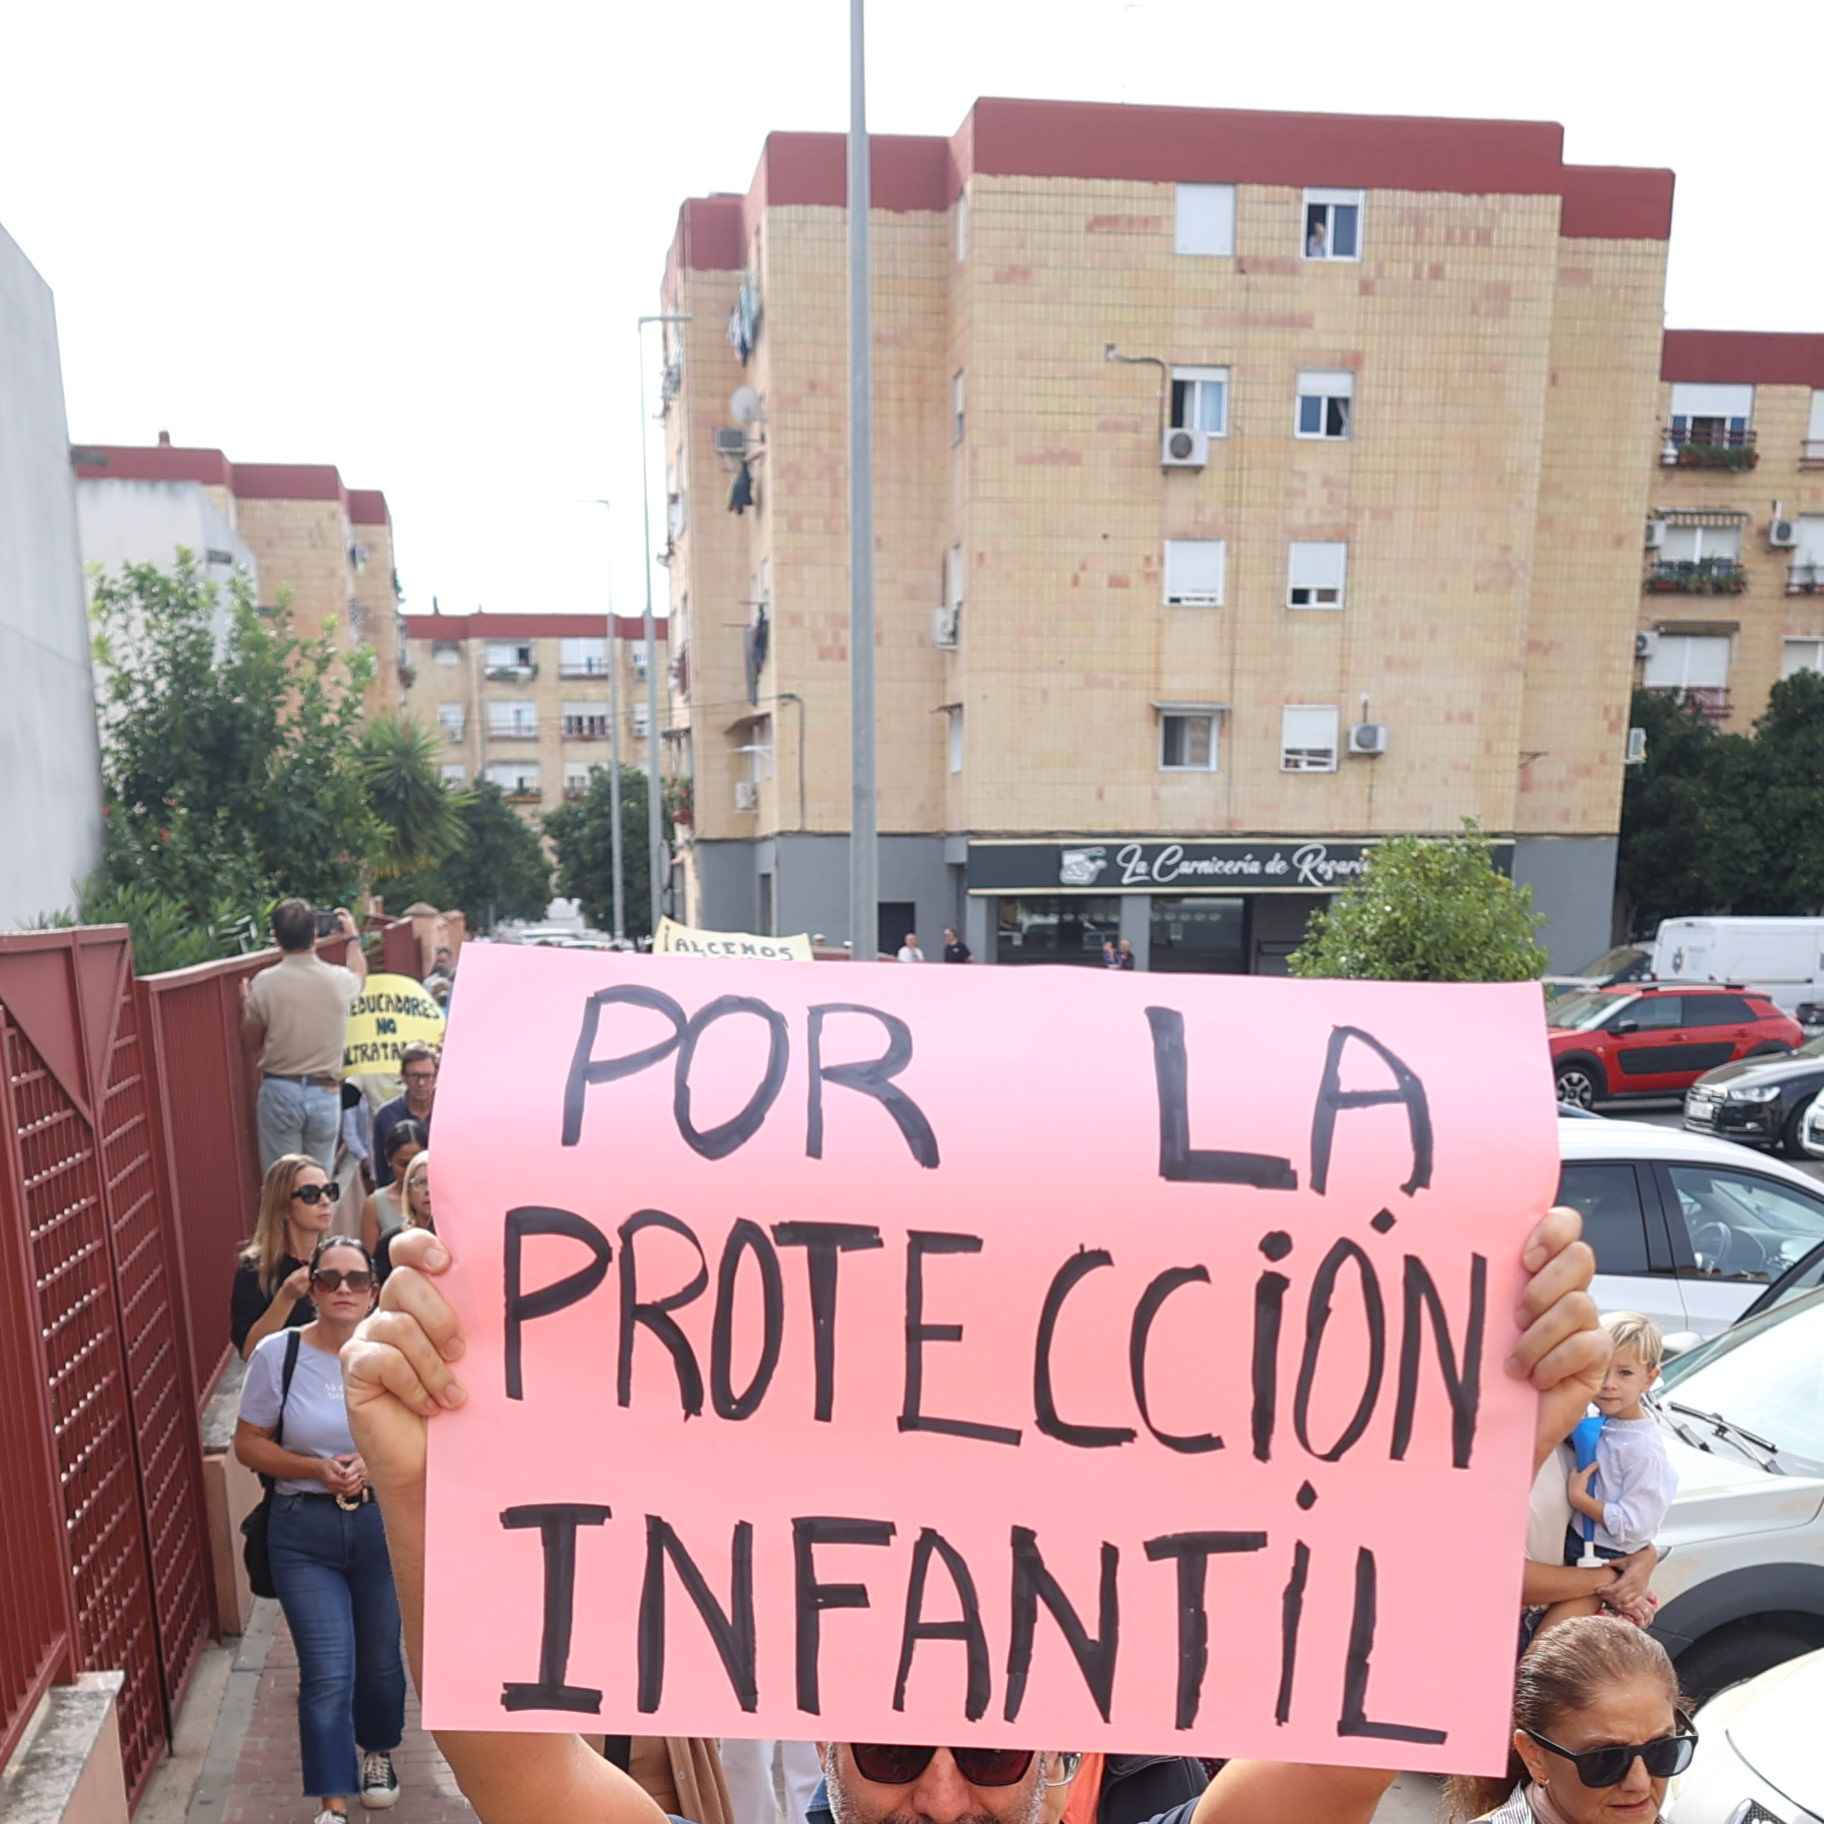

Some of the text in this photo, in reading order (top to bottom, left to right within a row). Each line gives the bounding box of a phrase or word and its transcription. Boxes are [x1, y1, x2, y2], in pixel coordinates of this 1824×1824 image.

[1116, 844, 1151, 885] La
[1152, 844, 1261, 883] Carnicería
[1264, 852, 1290, 875] de
[375, 1016, 398, 1036] NO
[561, 984, 1434, 1197] POR LA
